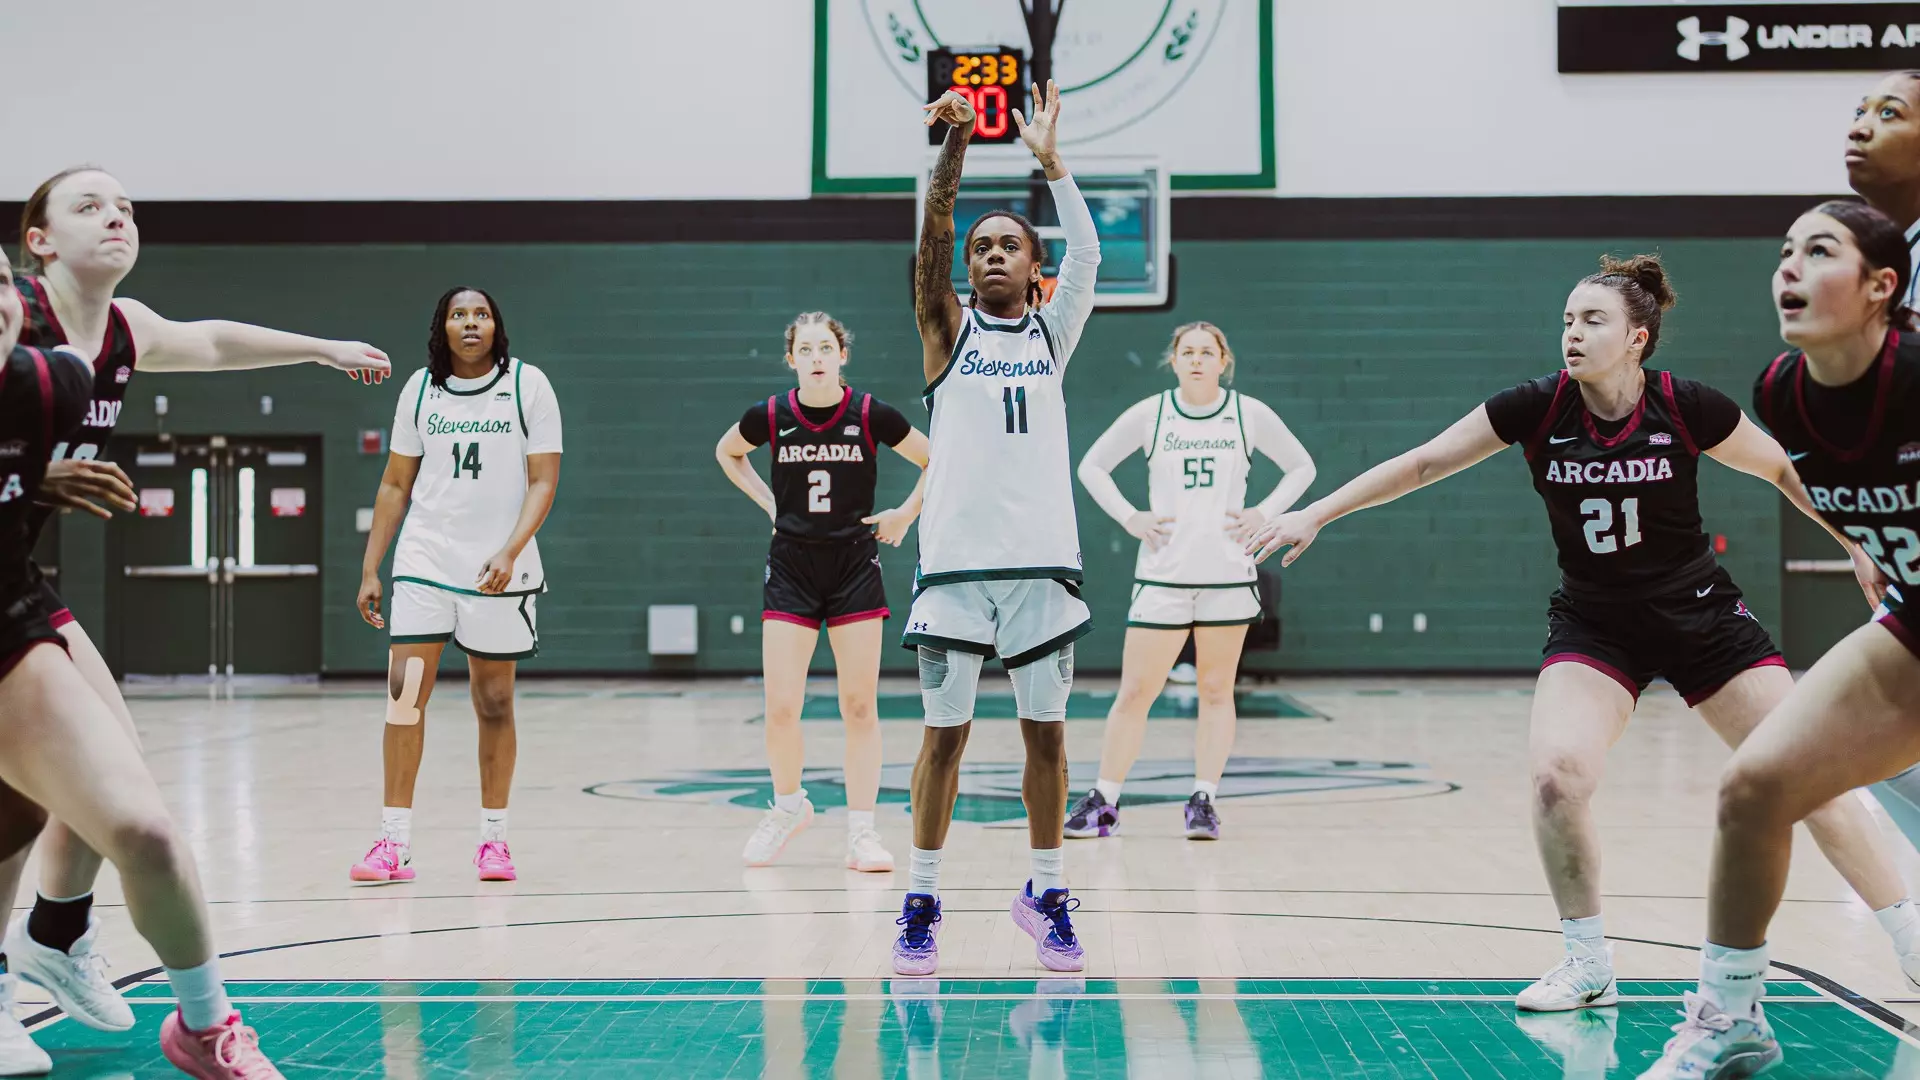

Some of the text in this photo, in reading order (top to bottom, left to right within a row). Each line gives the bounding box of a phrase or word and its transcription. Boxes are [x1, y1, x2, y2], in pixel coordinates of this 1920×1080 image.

[1757, 24, 1873, 49] UNDER
[952, 55, 1018, 85] 2:33
[427, 413, 512, 435] Stevenson
[1003, 386, 1029, 434] 11
[778, 444, 864, 463] ARCADIA
[1164, 432, 1237, 452] Stevenson
[451, 442, 482, 479] 14
[1183, 457, 1216, 490] 55
[1546, 458, 1673, 484] ARCADIA
[807, 469, 832, 513] 2
[1580, 497, 1642, 554] 21
